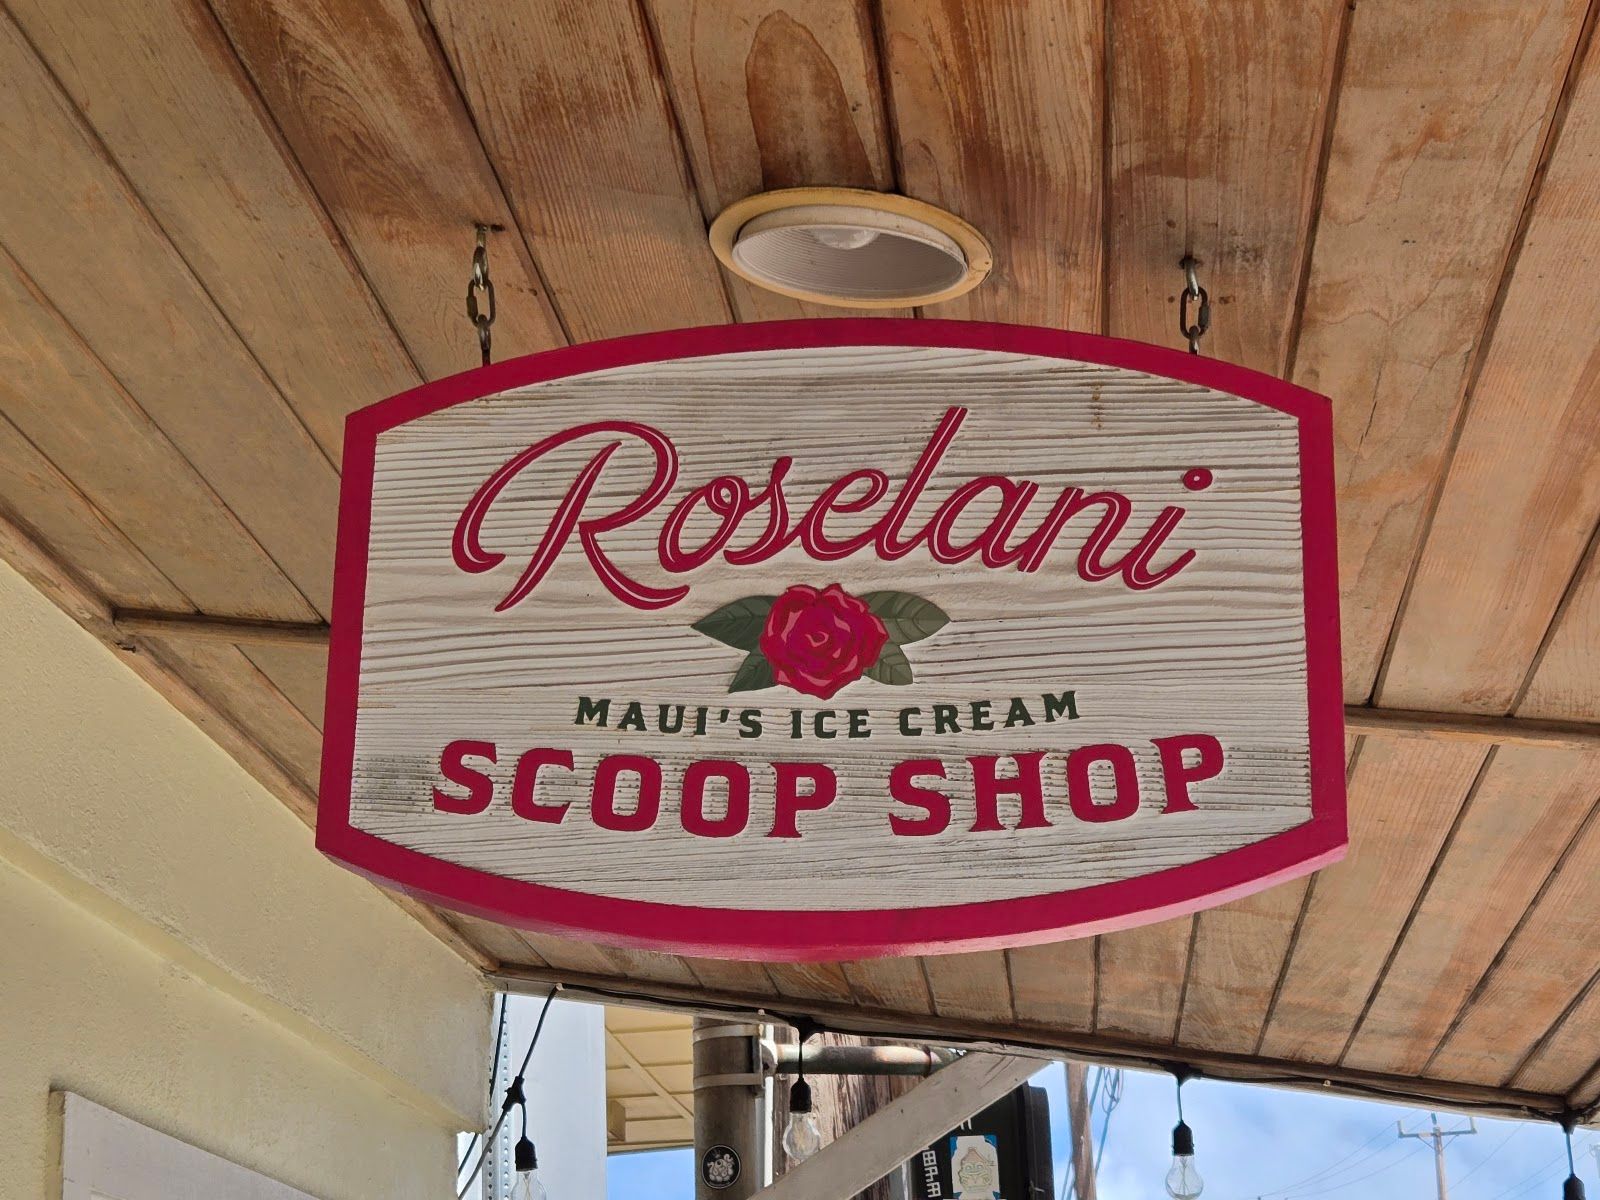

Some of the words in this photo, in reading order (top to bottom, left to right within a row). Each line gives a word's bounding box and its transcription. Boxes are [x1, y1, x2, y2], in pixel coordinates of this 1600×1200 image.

[452, 406, 1213, 612] Roselani
[574, 695, 763, 738] MAUI'S
[791, 708, 871, 739] ICE
[899, 690, 1080, 737] CREAM
[432, 740, 837, 838] SCOOP
[889, 733, 1224, 837] SHOP
